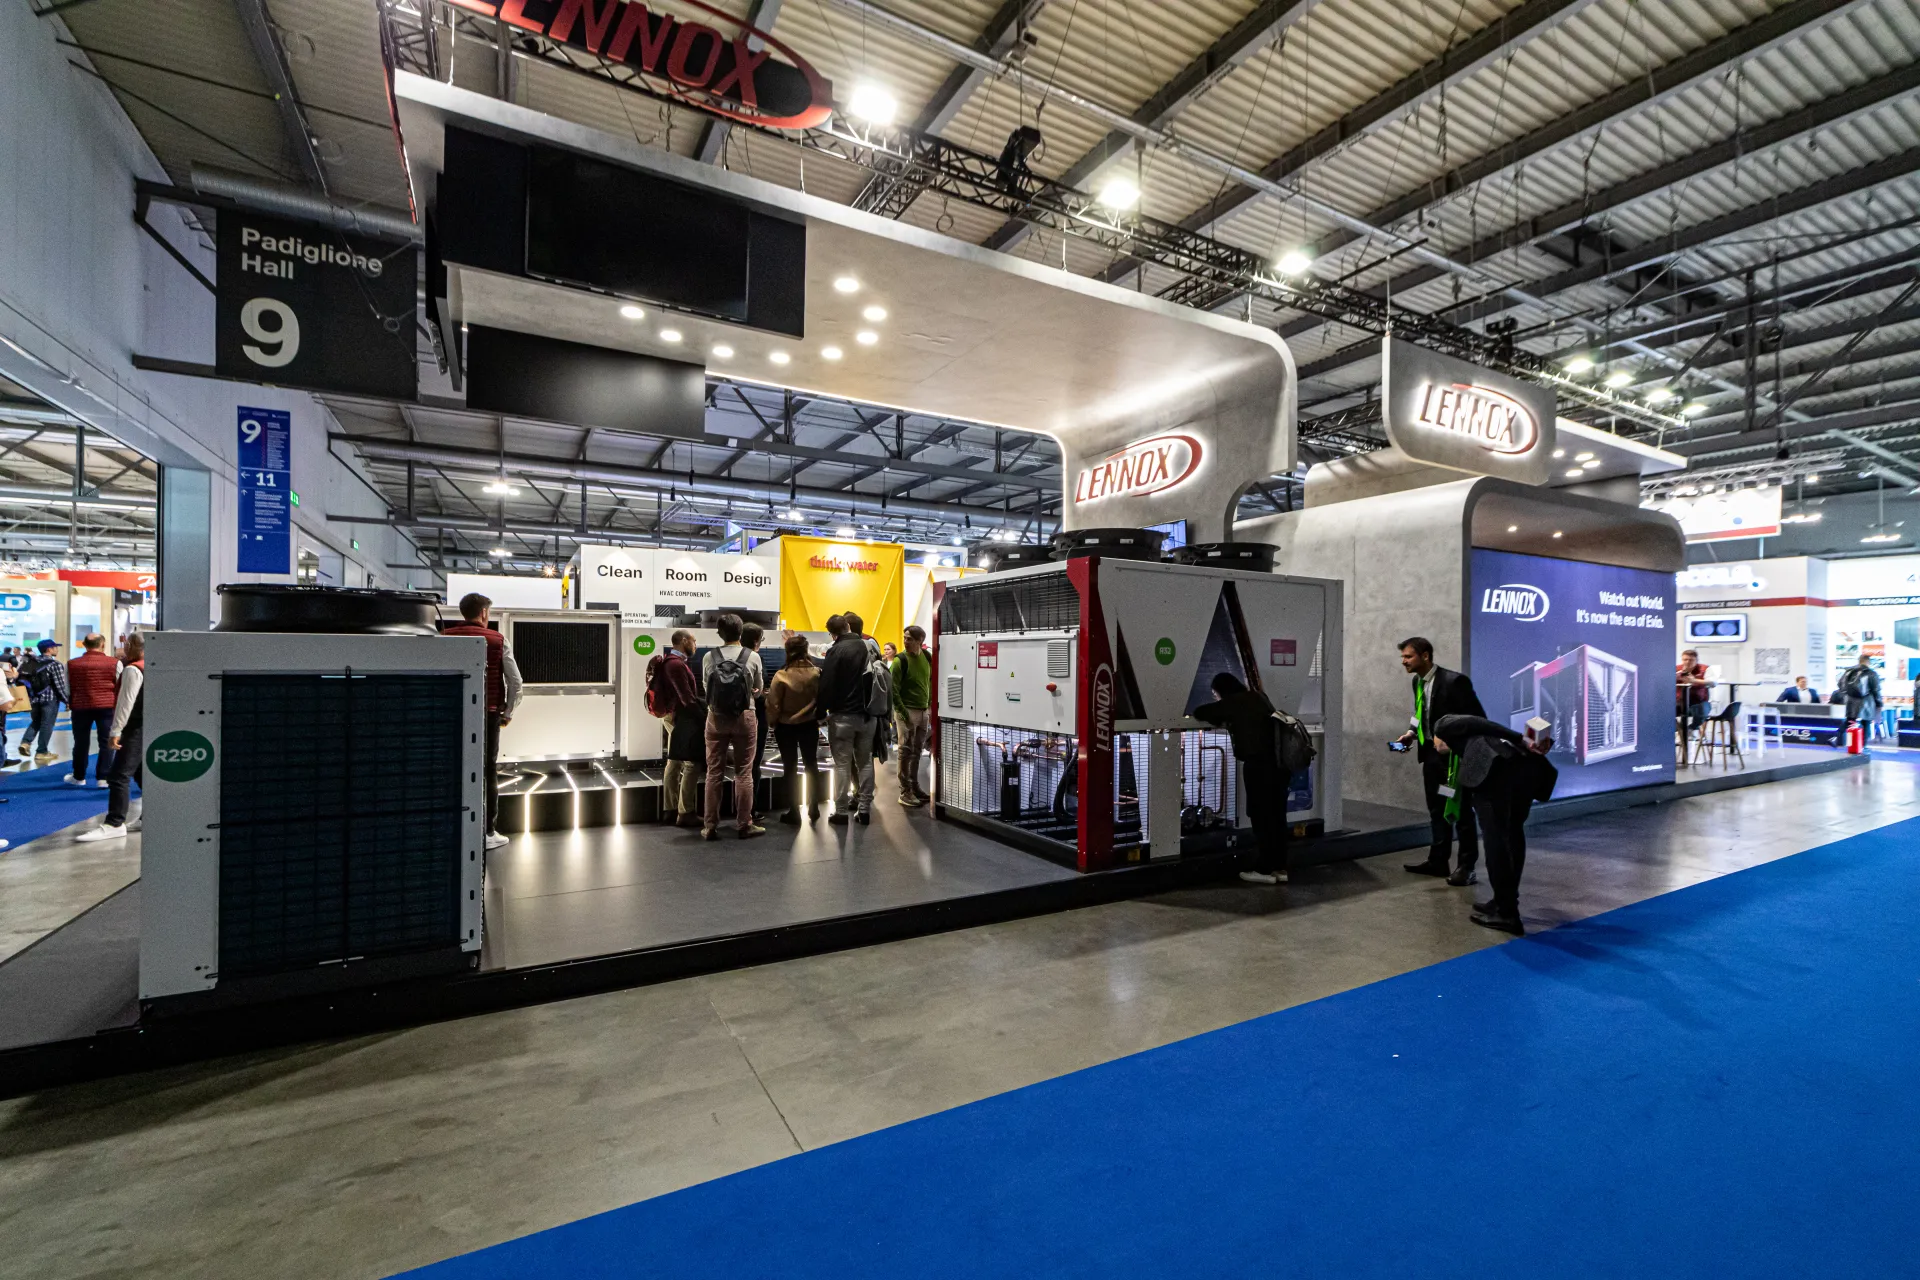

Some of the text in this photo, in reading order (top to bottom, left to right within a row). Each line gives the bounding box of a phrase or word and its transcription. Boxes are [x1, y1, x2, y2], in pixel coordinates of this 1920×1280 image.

[241, 227, 383, 273] Padiglione
[241, 252, 294, 279] Hall
[240, 297, 300, 368] 9
[1419, 384, 1517, 444] LENNOX
[241, 419, 262, 443] 9
[256, 472, 277, 487] 11
[1075, 444, 1172, 503] LENNOX
[597, 564, 772, 587] Clean Room Design
[1481, 588, 1538, 615] LENNOX
[1599, 591, 1625, 607] Watch
[1626, 595, 1639, 608] out
[1576, 608, 1590, 624] It's
[1590, 612, 1609, 625] now
[1609, 611, 1623, 626] the
[1623, 615, 1637, 627] era
[1636, 613, 1647, 628] of
[1159, 646, 1172, 655] R32
[1096, 681, 1110, 752] LENNOX
[153, 747, 208, 763] R290
